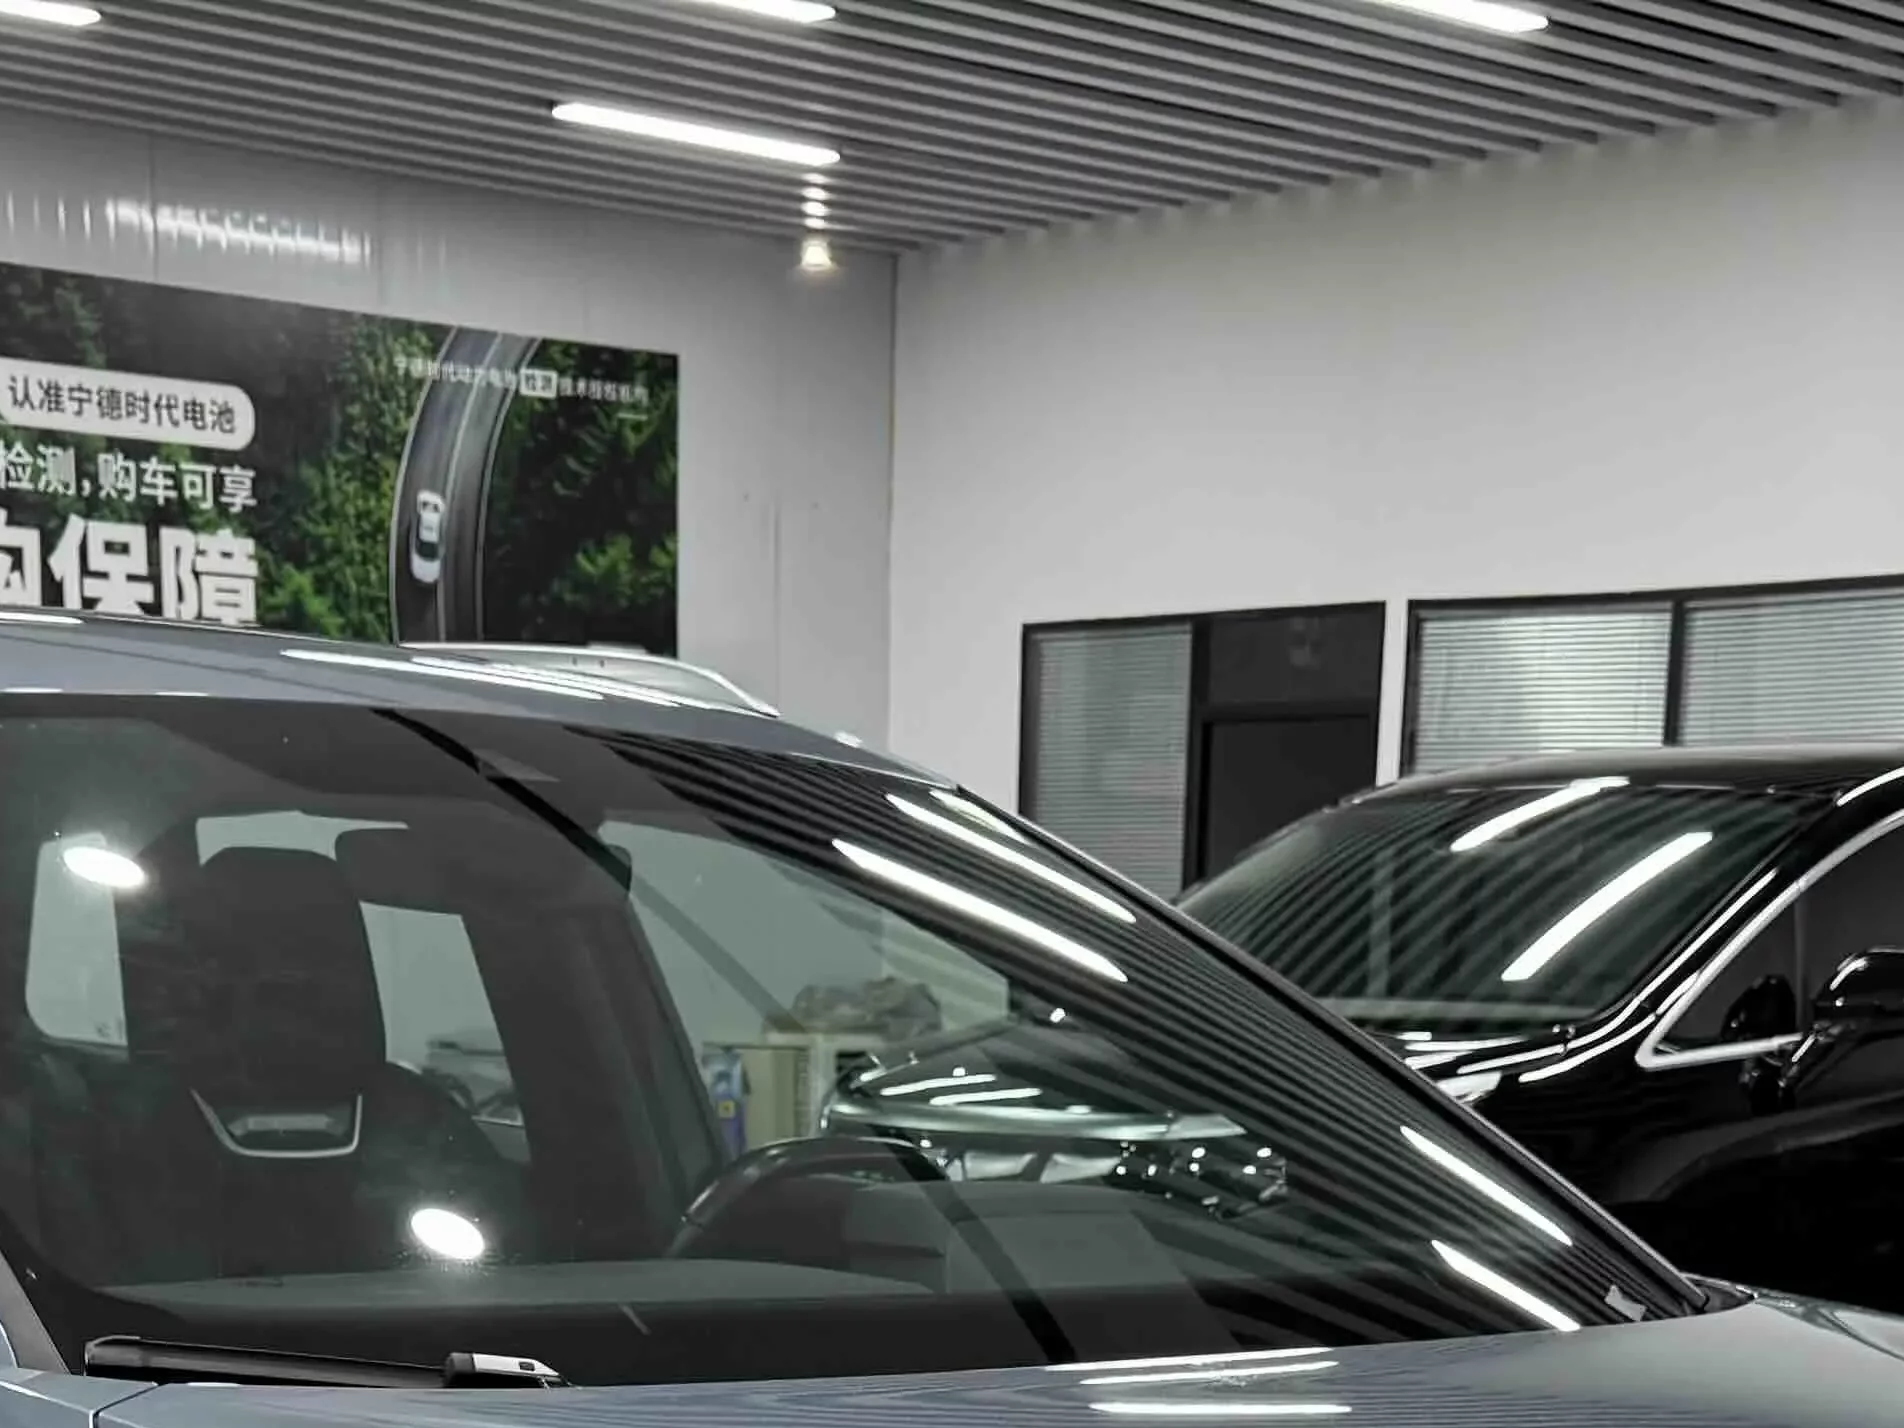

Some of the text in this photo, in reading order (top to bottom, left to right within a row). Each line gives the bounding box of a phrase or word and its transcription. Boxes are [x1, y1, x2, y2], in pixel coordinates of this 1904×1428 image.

[6, 373, 237, 435] 认准宁德时代电池
